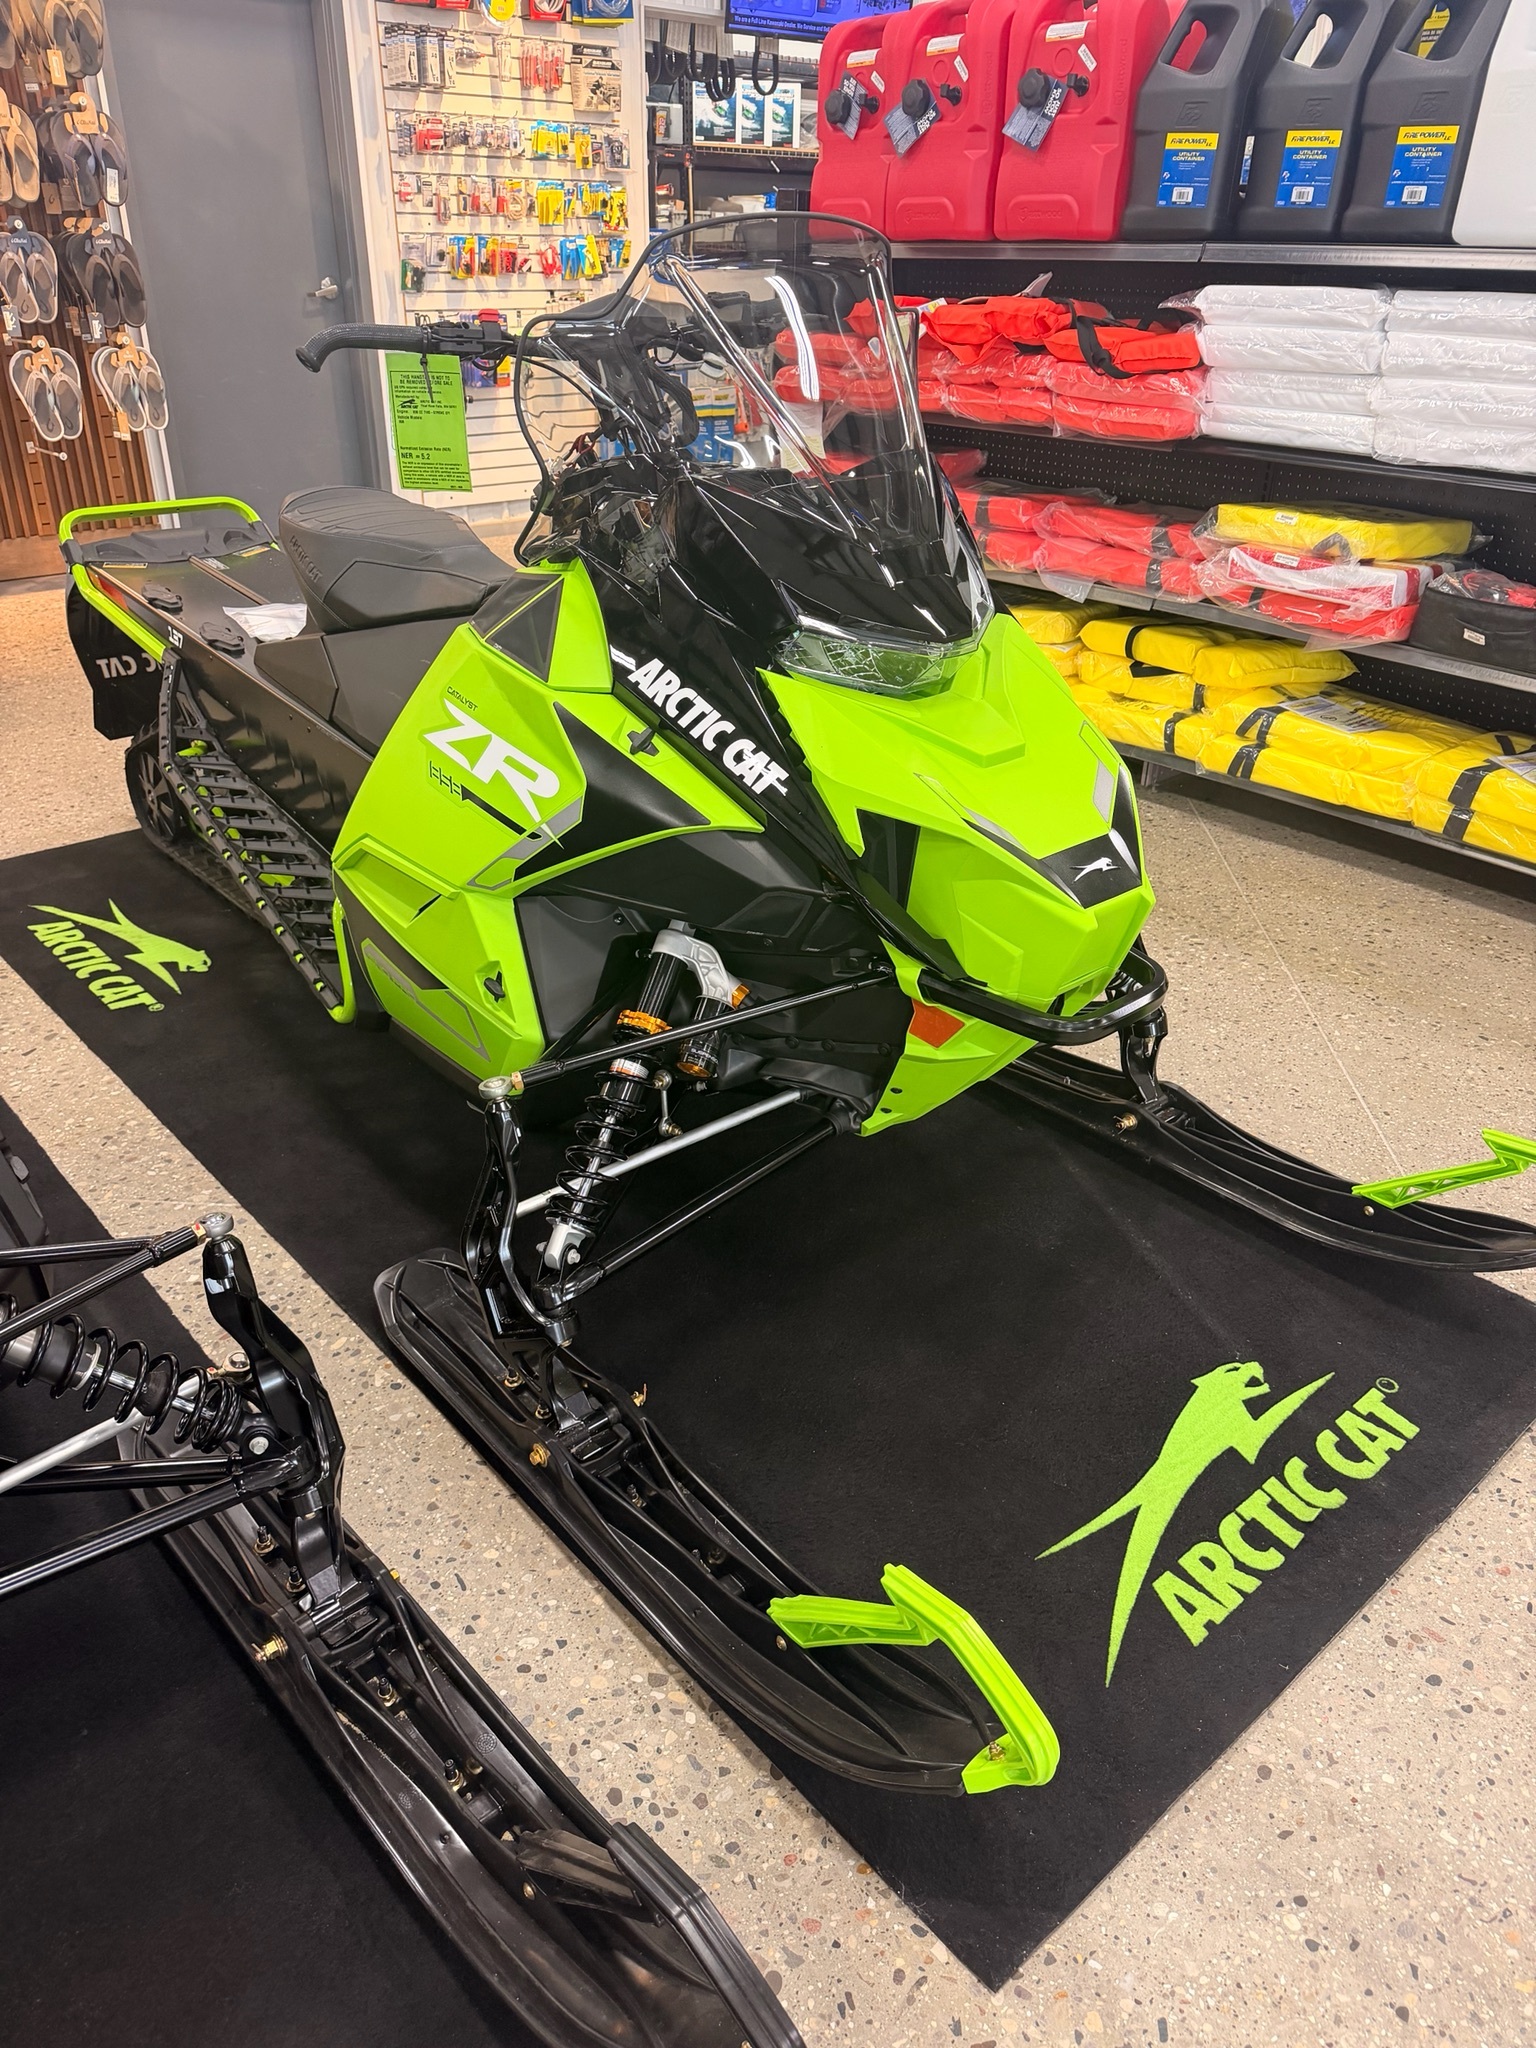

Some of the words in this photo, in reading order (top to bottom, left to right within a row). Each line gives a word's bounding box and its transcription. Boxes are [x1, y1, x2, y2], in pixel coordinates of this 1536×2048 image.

[446, 686, 478, 711] CATALYST
[627, 658, 736, 751] ARCTIC
[722, 738, 790, 795] CAT
[423, 697, 564, 849] ZR
[27, 921, 122, 979] ARCTIC
[1152, 1456, 1348, 1647] ARCTIC
[1315, 1387, 1421, 1480] CAT
